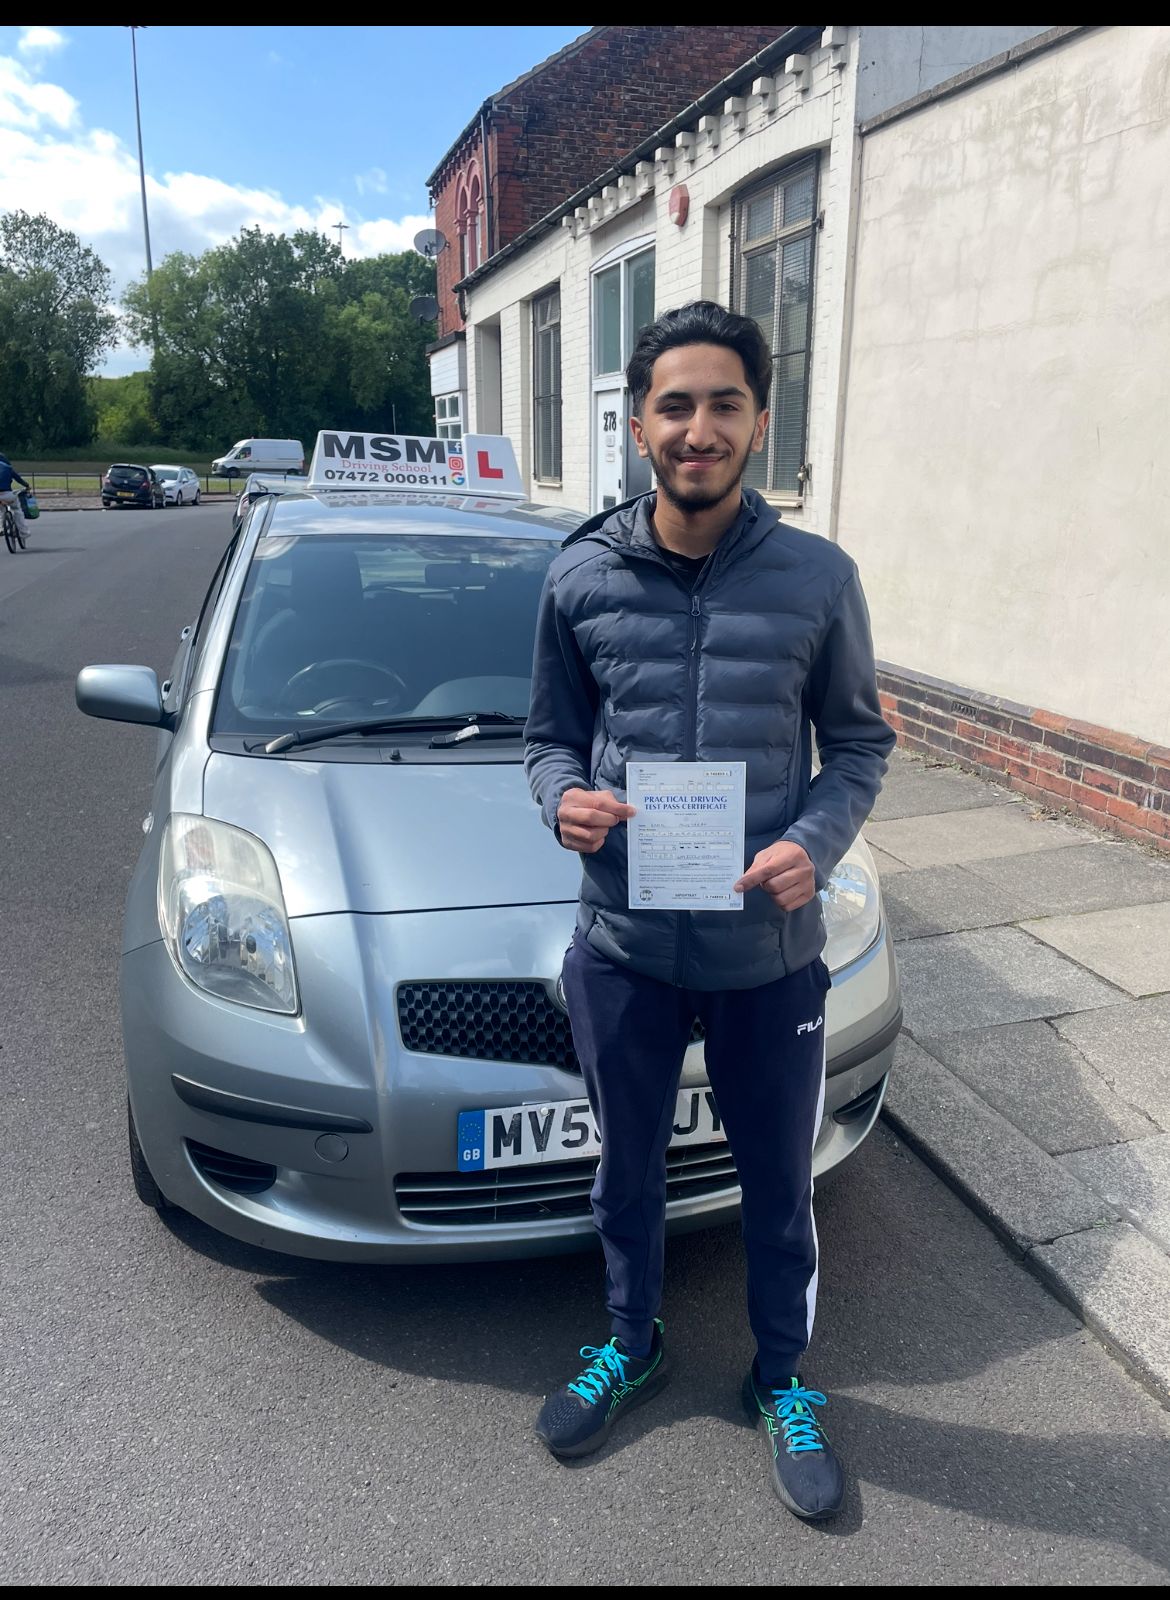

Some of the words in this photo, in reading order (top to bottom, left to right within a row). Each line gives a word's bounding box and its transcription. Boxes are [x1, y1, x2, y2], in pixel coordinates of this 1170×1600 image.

[603, 410, 617, 432] 278
[323, 434, 446, 464] MSM
[341, 459, 389, 473] Driving
[391, 462, 433, 473] School
[477, 451, 504, 479] L
[324, 469, 379, 483] 07472
[384, 472, 447, 485] 000811
[644, 795, 689, 803] PRACTICAL
[690, 795, 728, 803] DRIVING
[645, 803, 661, 811] TEST
[663, 803, 680, 811] PASS
[681, 803, 728, 811] CERTIFICATE
[797, 1015, 823, 1036] FILA
[492, 1104, 602, 1159] MV5
[463, 1148, 481, 1162] GB
